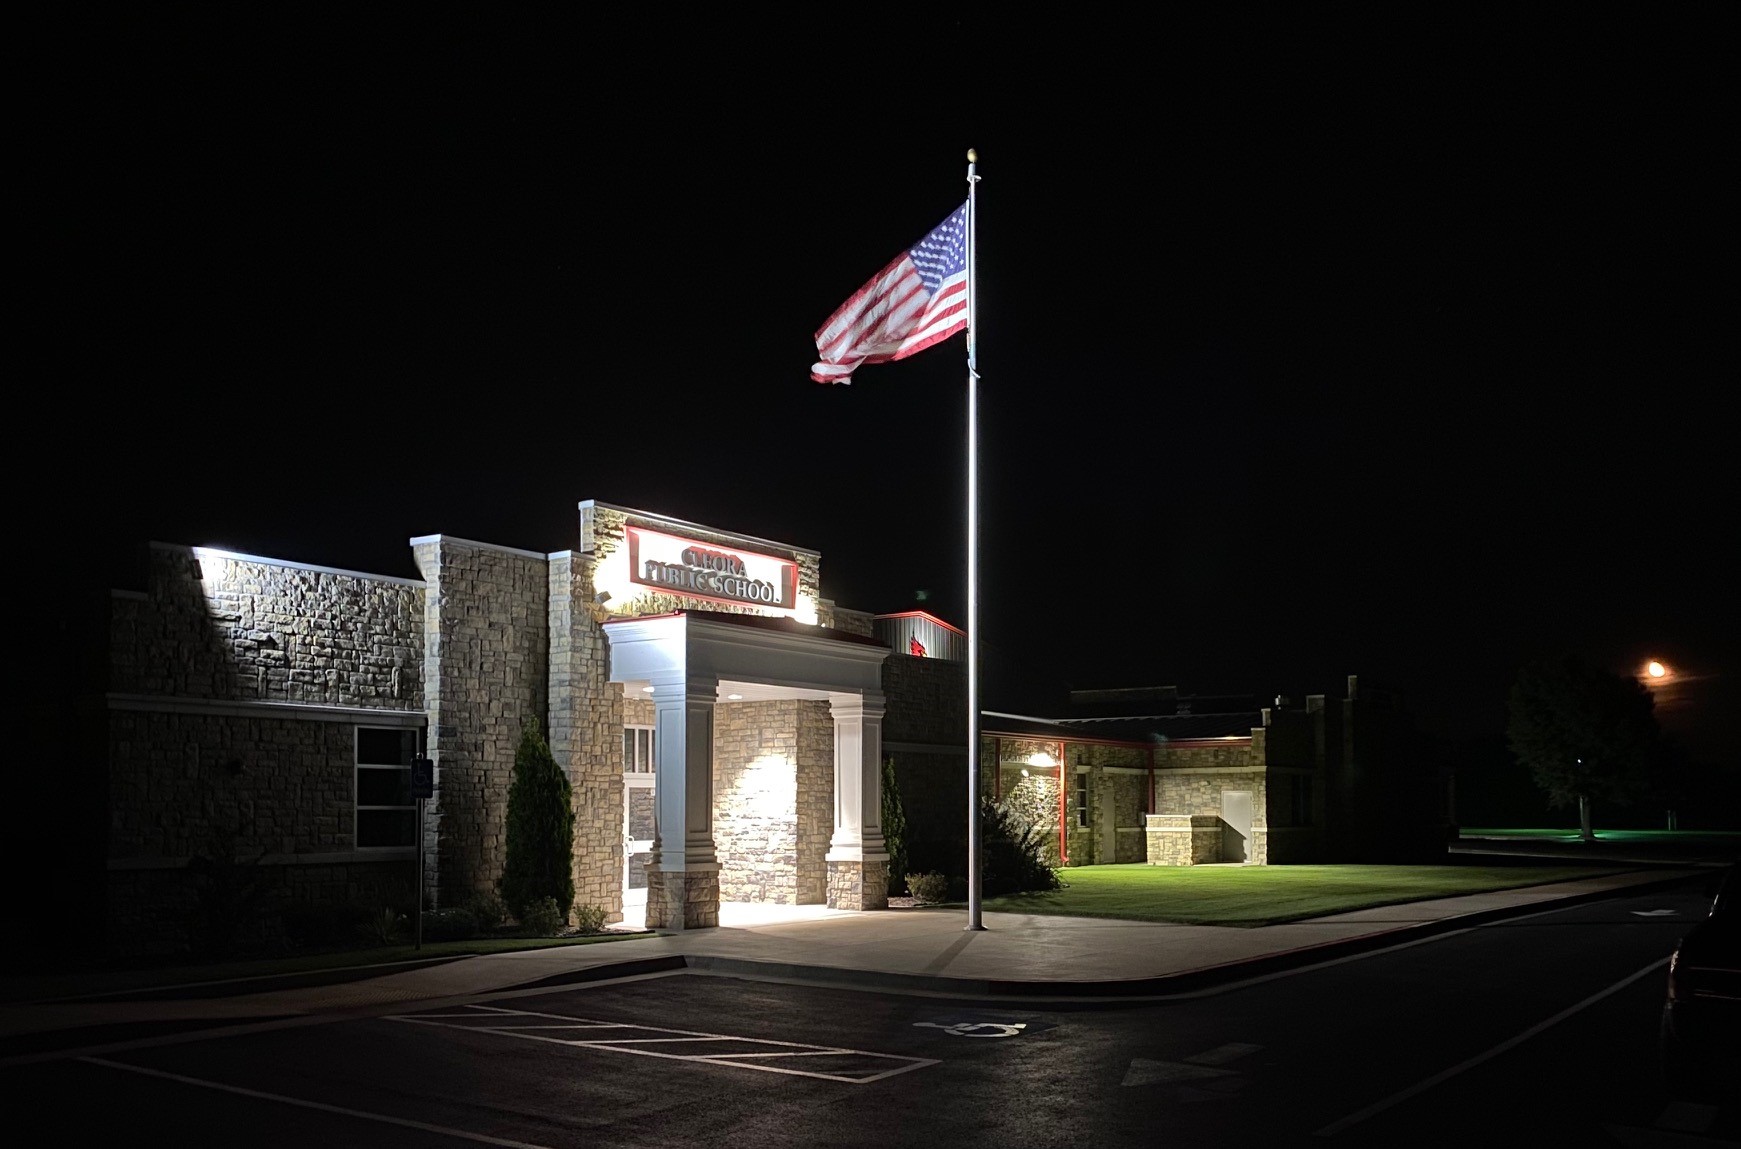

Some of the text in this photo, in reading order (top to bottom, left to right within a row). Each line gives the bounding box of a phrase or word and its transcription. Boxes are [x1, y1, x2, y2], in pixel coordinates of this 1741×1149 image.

[681, 549, 748, 577] CLEORA
[645, 563, 782, 604] PUBLIC SCHOOL
